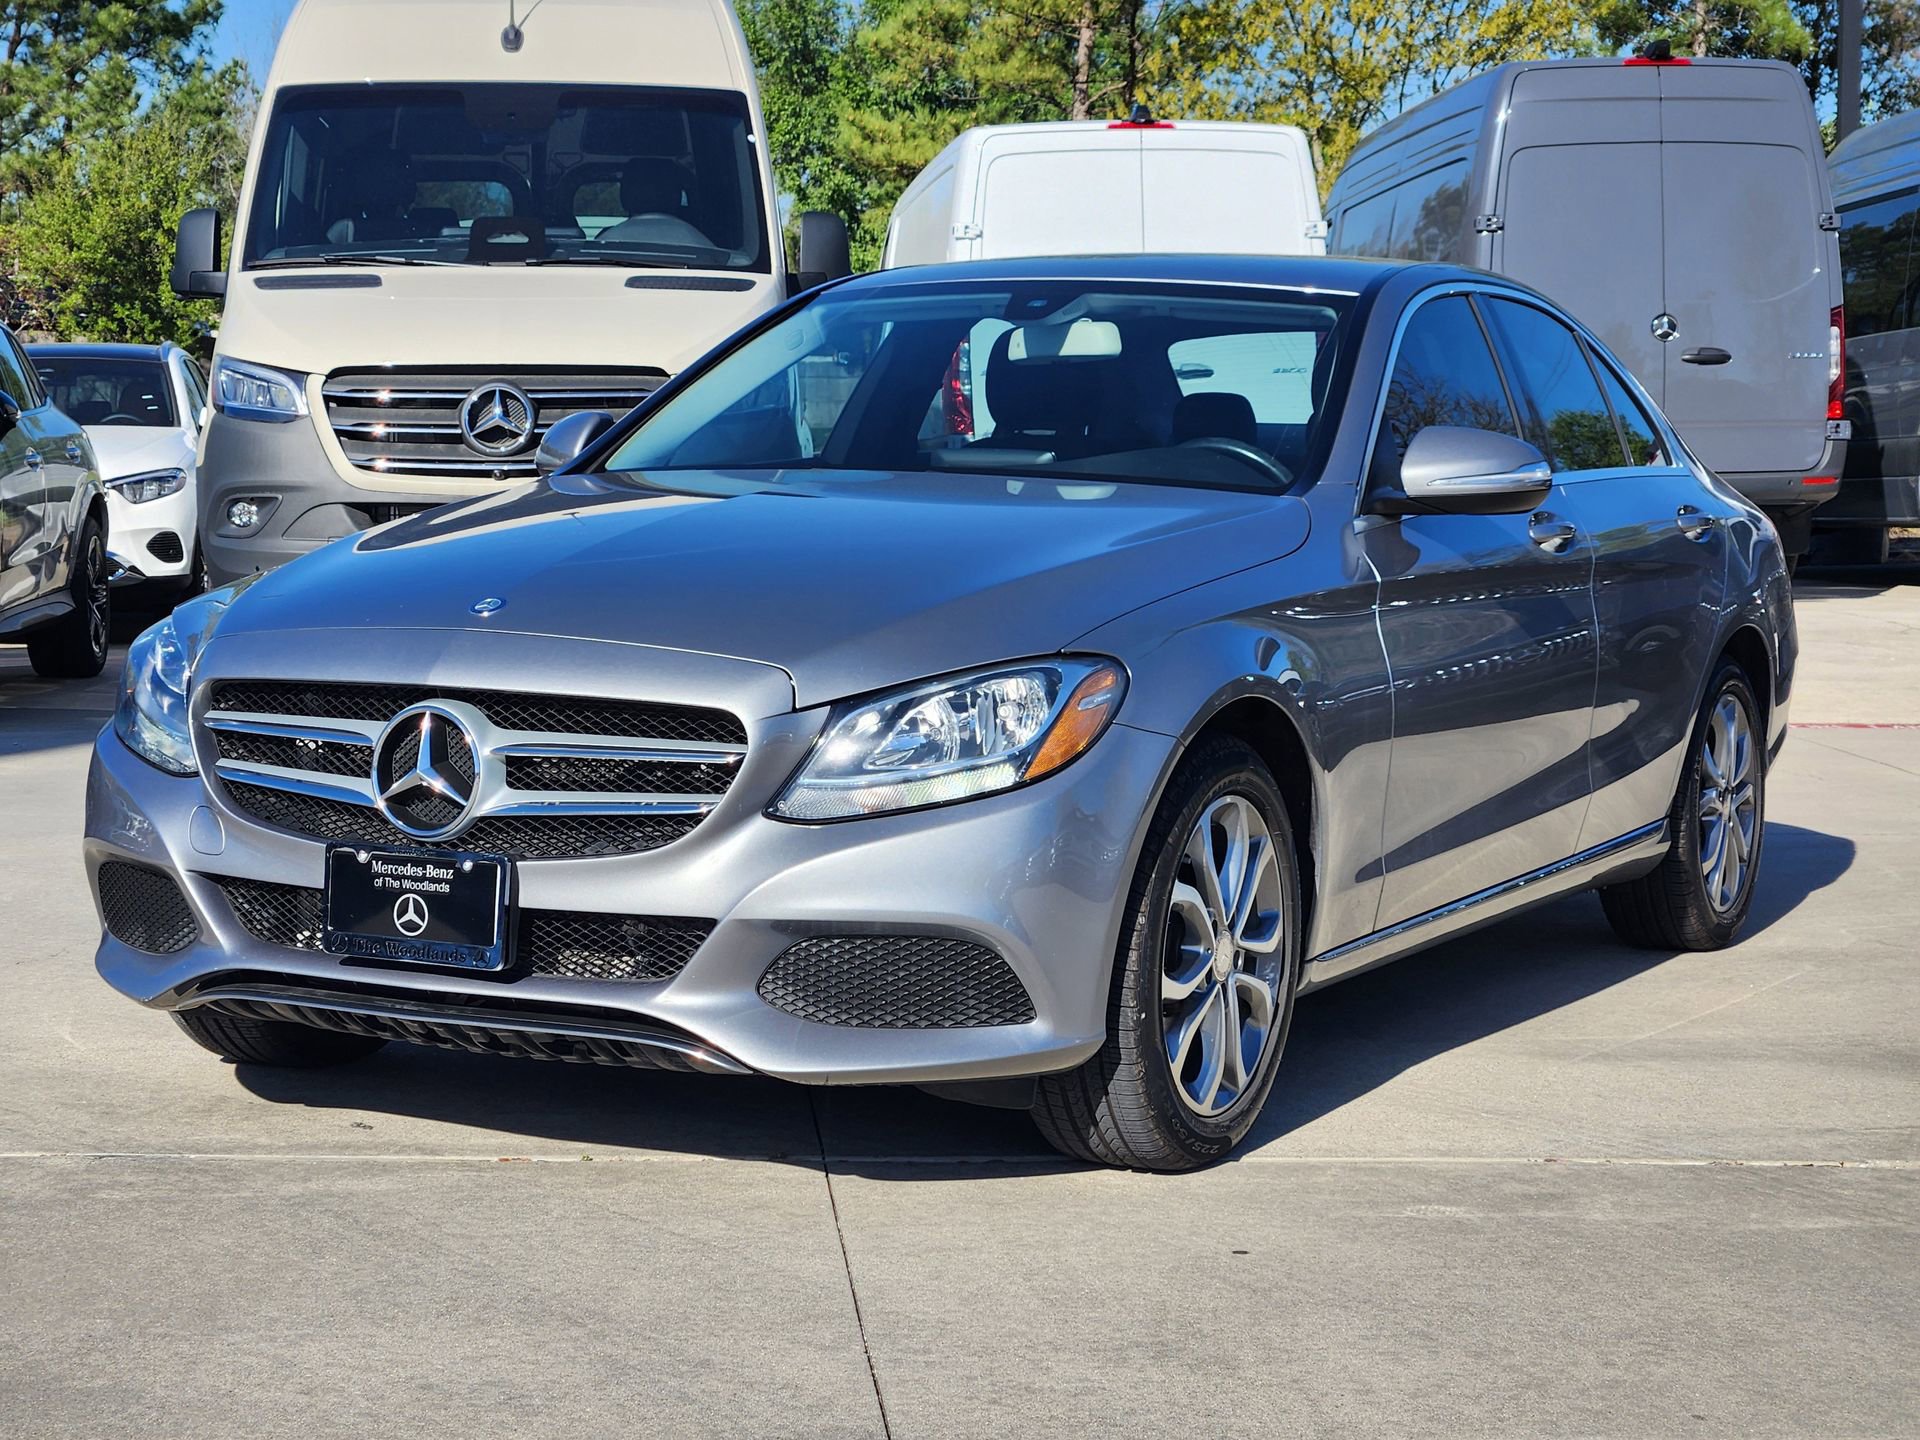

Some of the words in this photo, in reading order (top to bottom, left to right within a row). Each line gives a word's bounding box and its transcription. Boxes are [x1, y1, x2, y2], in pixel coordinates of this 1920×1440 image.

[371, 860, 454, 880] Mercedes-Benz
[374, 876, 384, 888] of
[384, 877, 401, 889] The
[401, 880, 450, 893] Woodlands
[352, 937, 381, 954] The
[385, 941, 467, 963] Woodlands
